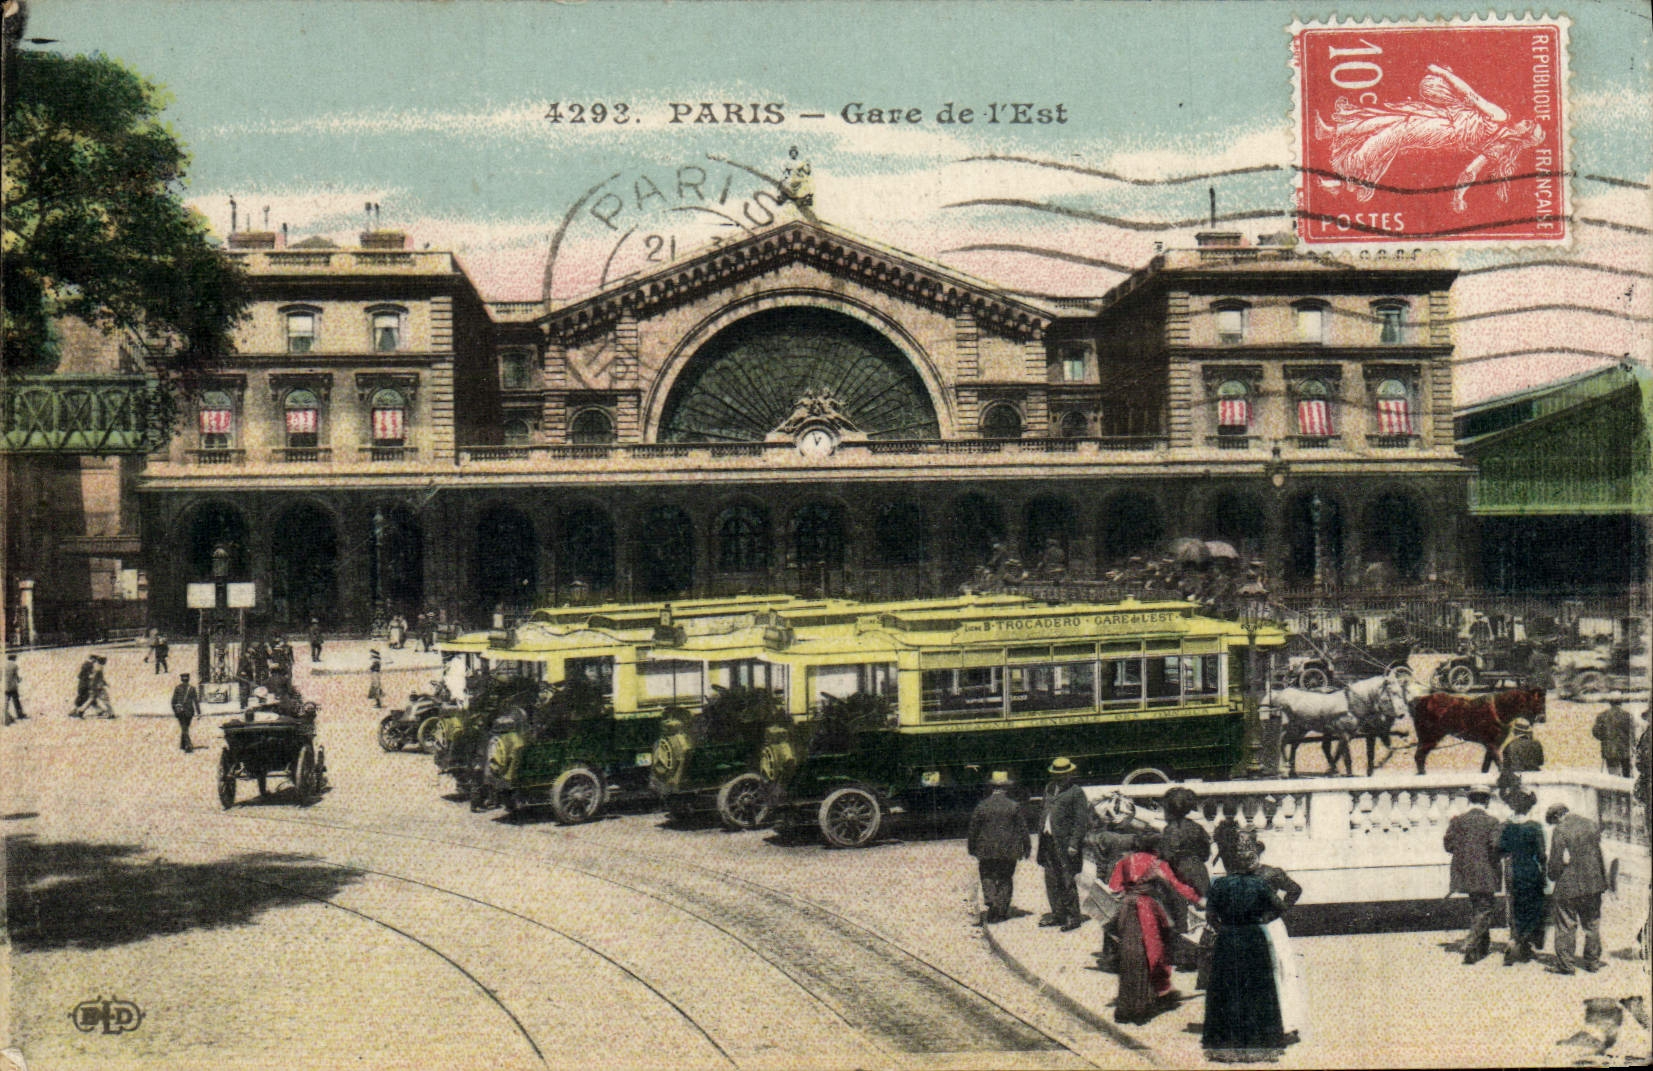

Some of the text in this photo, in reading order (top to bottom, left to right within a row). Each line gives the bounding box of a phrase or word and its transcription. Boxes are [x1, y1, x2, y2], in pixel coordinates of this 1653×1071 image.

[1328, 38, 1383, 89] 10
[589, 164, 781, 230] PARIS
[1533, 148, 1554, 231] FRANÇAISE
[1321, 211, 1405, 233] POSTES
[995, 616, 1081, 630] TROCADERO
[1094, 614, 1129, 626] GARE
